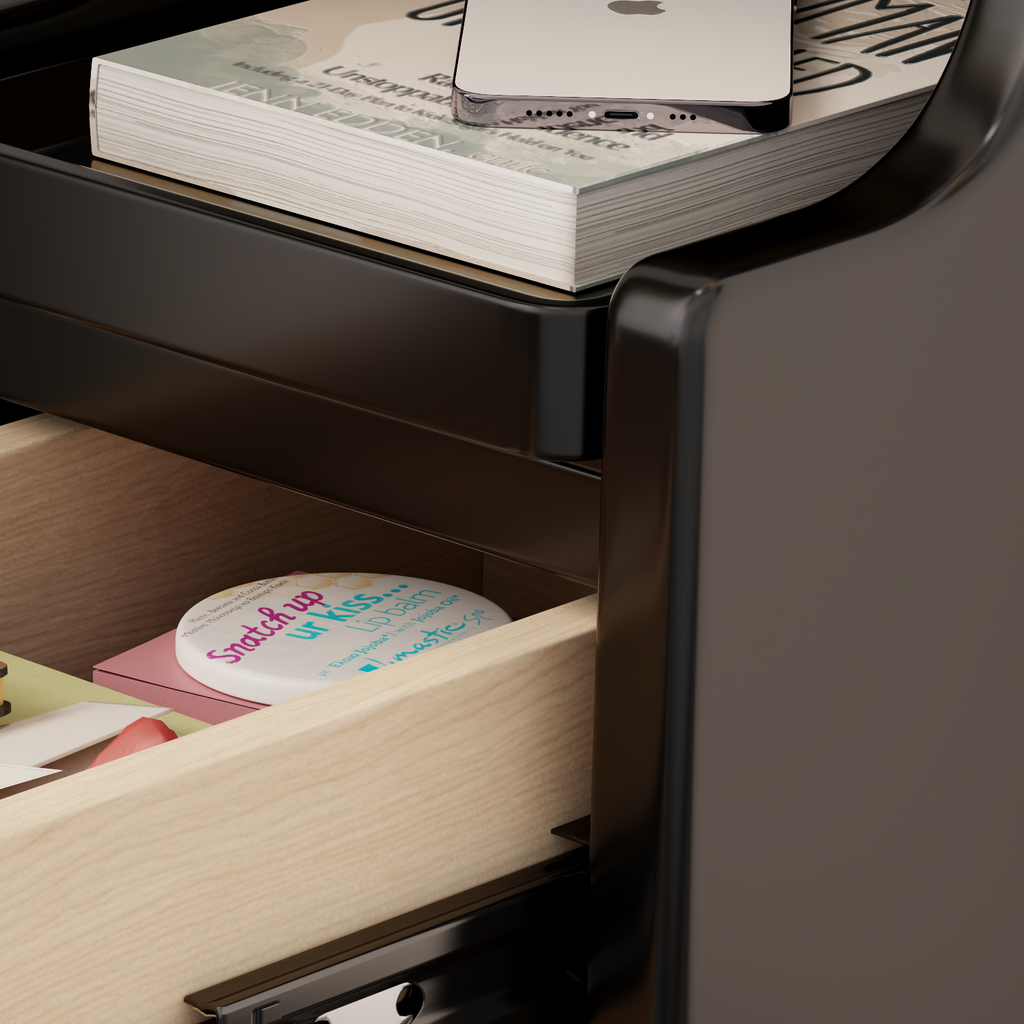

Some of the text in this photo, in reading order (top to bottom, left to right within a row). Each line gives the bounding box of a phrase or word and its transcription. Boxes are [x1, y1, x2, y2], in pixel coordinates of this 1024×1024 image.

[206, 590, 324, 664] Snatch up
[345, 589, 442, 633] Lip balm
[410, 606, 446, 623] Jojoba
[285, 621, 330, 641] ur
